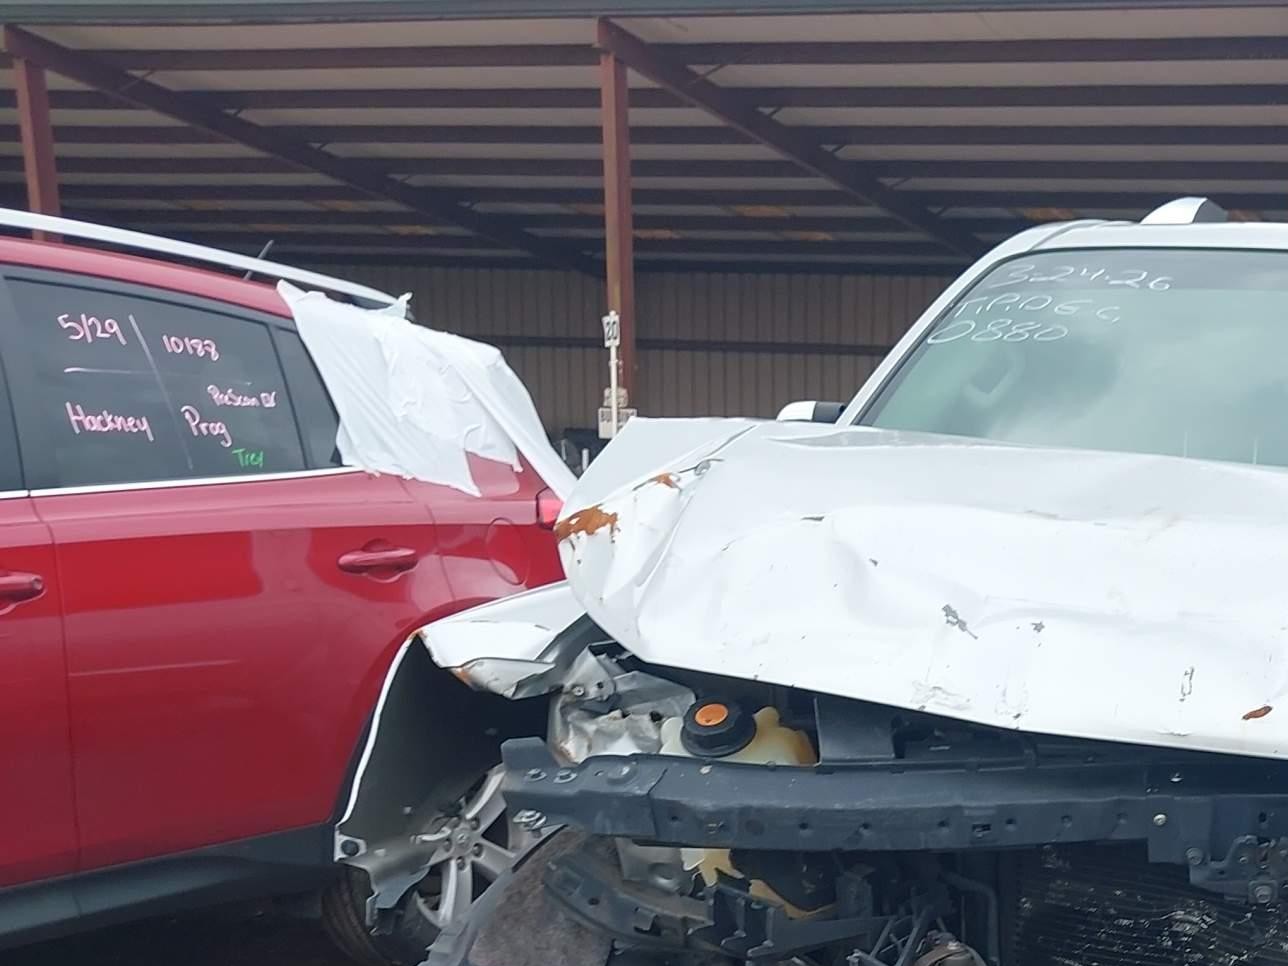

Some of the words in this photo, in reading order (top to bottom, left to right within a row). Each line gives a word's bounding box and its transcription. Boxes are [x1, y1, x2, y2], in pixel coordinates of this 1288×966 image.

[57, 313, 127, 345] 5/29
[65, 401, 154, 442] Hackney
[181, 405, 232, 447] Prog
